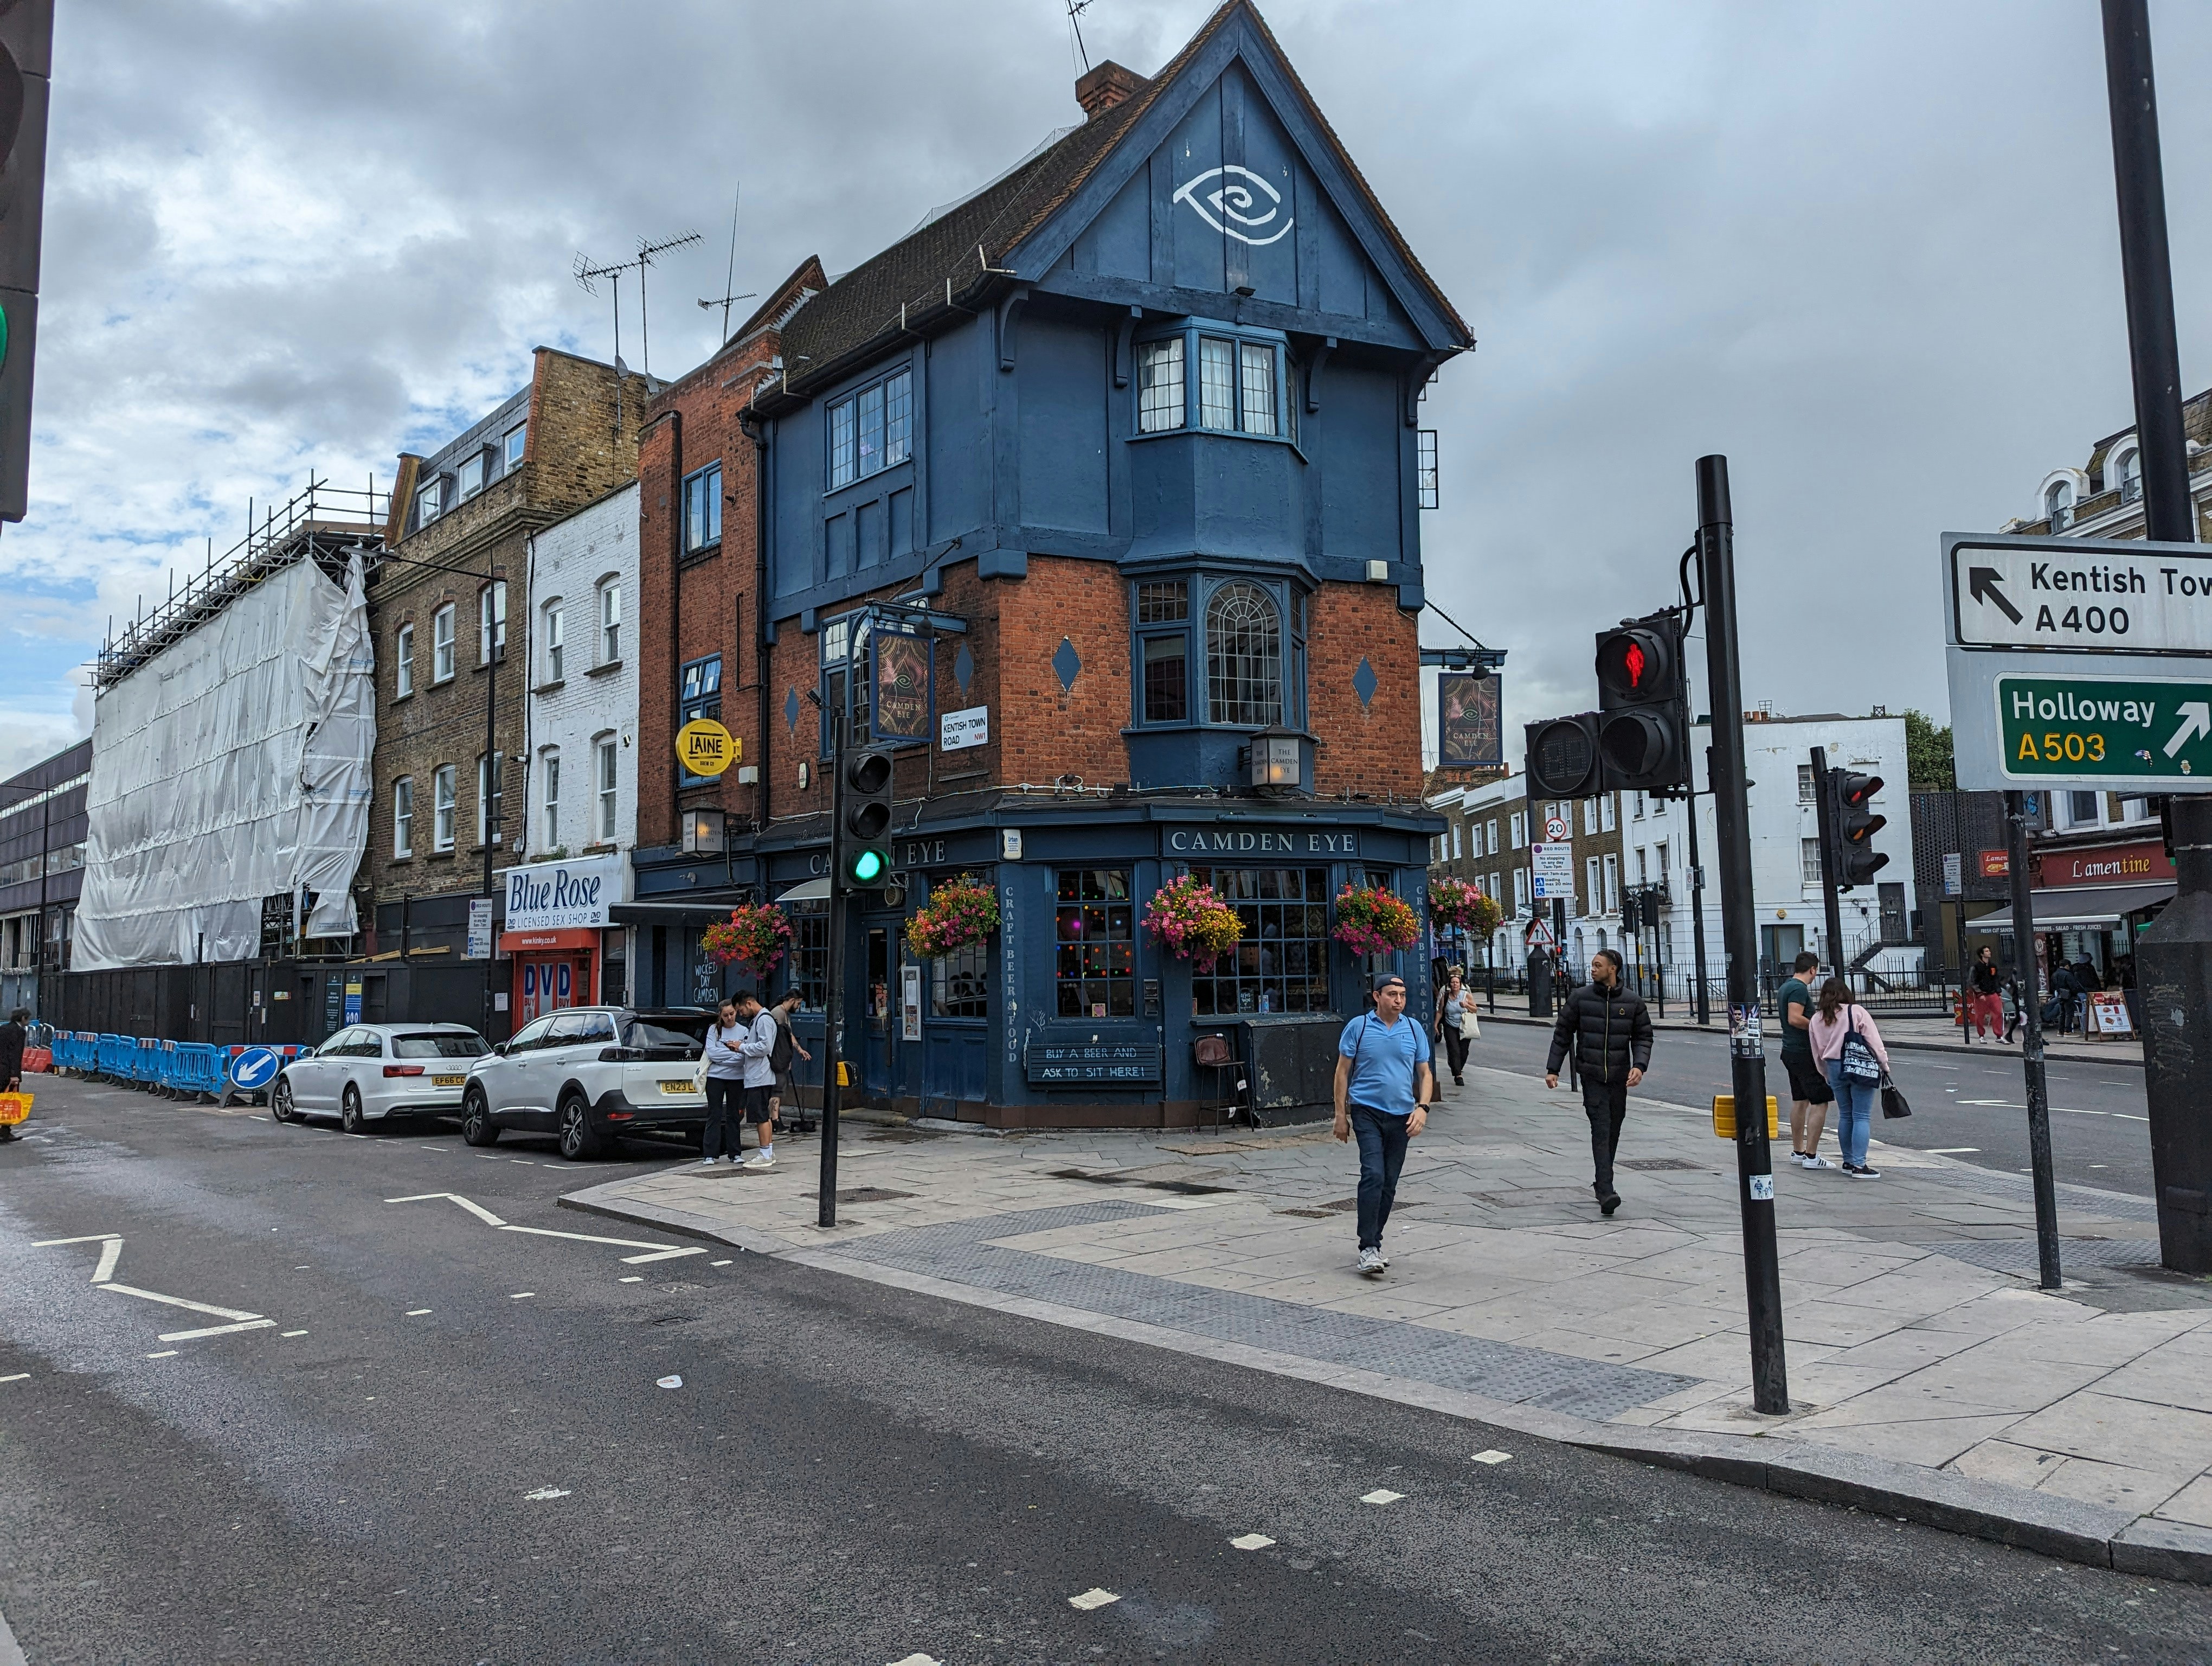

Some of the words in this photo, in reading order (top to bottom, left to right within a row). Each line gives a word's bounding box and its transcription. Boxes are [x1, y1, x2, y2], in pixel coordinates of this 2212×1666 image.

[2030, 562, 2146, 594] Kentish
[2035, 605, 2129, 635] A400
[886, 701, 921, 711] CAMDEN
[2012, 691, 2155, 728] Holloway
[944, 720, 967, 733] KENTISH
[968, 716, 986, 729] TOWN
[689, 736, 723, 755] LAINE
[944, 735, 960, 746] ROAD
[974, 732, 986, 741] NW1
[2018, 733, 2105, 761] A503
[1548, 824, 1563, 832] 20
[1171, 831, 1294, 851] CAMDEN
[1308, 834, 1354, 851] EYE
[907, 841, 945, 864] EYE
[2072, 855, 2150, 877] Lamentine
[509, 873, 551, 913] Blue
[552, 869, 601, 909] Rose
[517, 915, 549, 928] LICENSED
[552, 914, 565, 926] SEX
[569, 912, 587, 925] SHOP
[1005, 887, 1014, 944] CRAFT
[522, 935, 557, 945] www.kinky.co.uk
[695, 961, 718, 976] WICKED
[1418, 942, 1426, 983] BEER
[525, 964, 570, 996] DVD
[700, 975, 710, 987] DAY
[1007, 950, 1015, 995] BEER
[694, 987, 718, 1003] CAMDEN
[1420, 988, 1427, 996] &
[524, 998, 535, 1007] BUY
[558, 998, 569, 1007] BUY
[1008, 1016, 1017, 1062] FOOD
[1046, 1049, 1065, 1059] BUY
[1069, 1048, 1078, 1058] A
[1084, 1048, 1109, 1058] BEER
[1113, 1047, 1137, 1058] AND
[1042, 1068, 1062, 1078] ASK
[1065, 1068, 1078, 1077] TO
[1086, 1067, 1103, 1077] SIT
[665, 1082, 686, 1091] EN23
[688, 1082, 695, 1091] L
